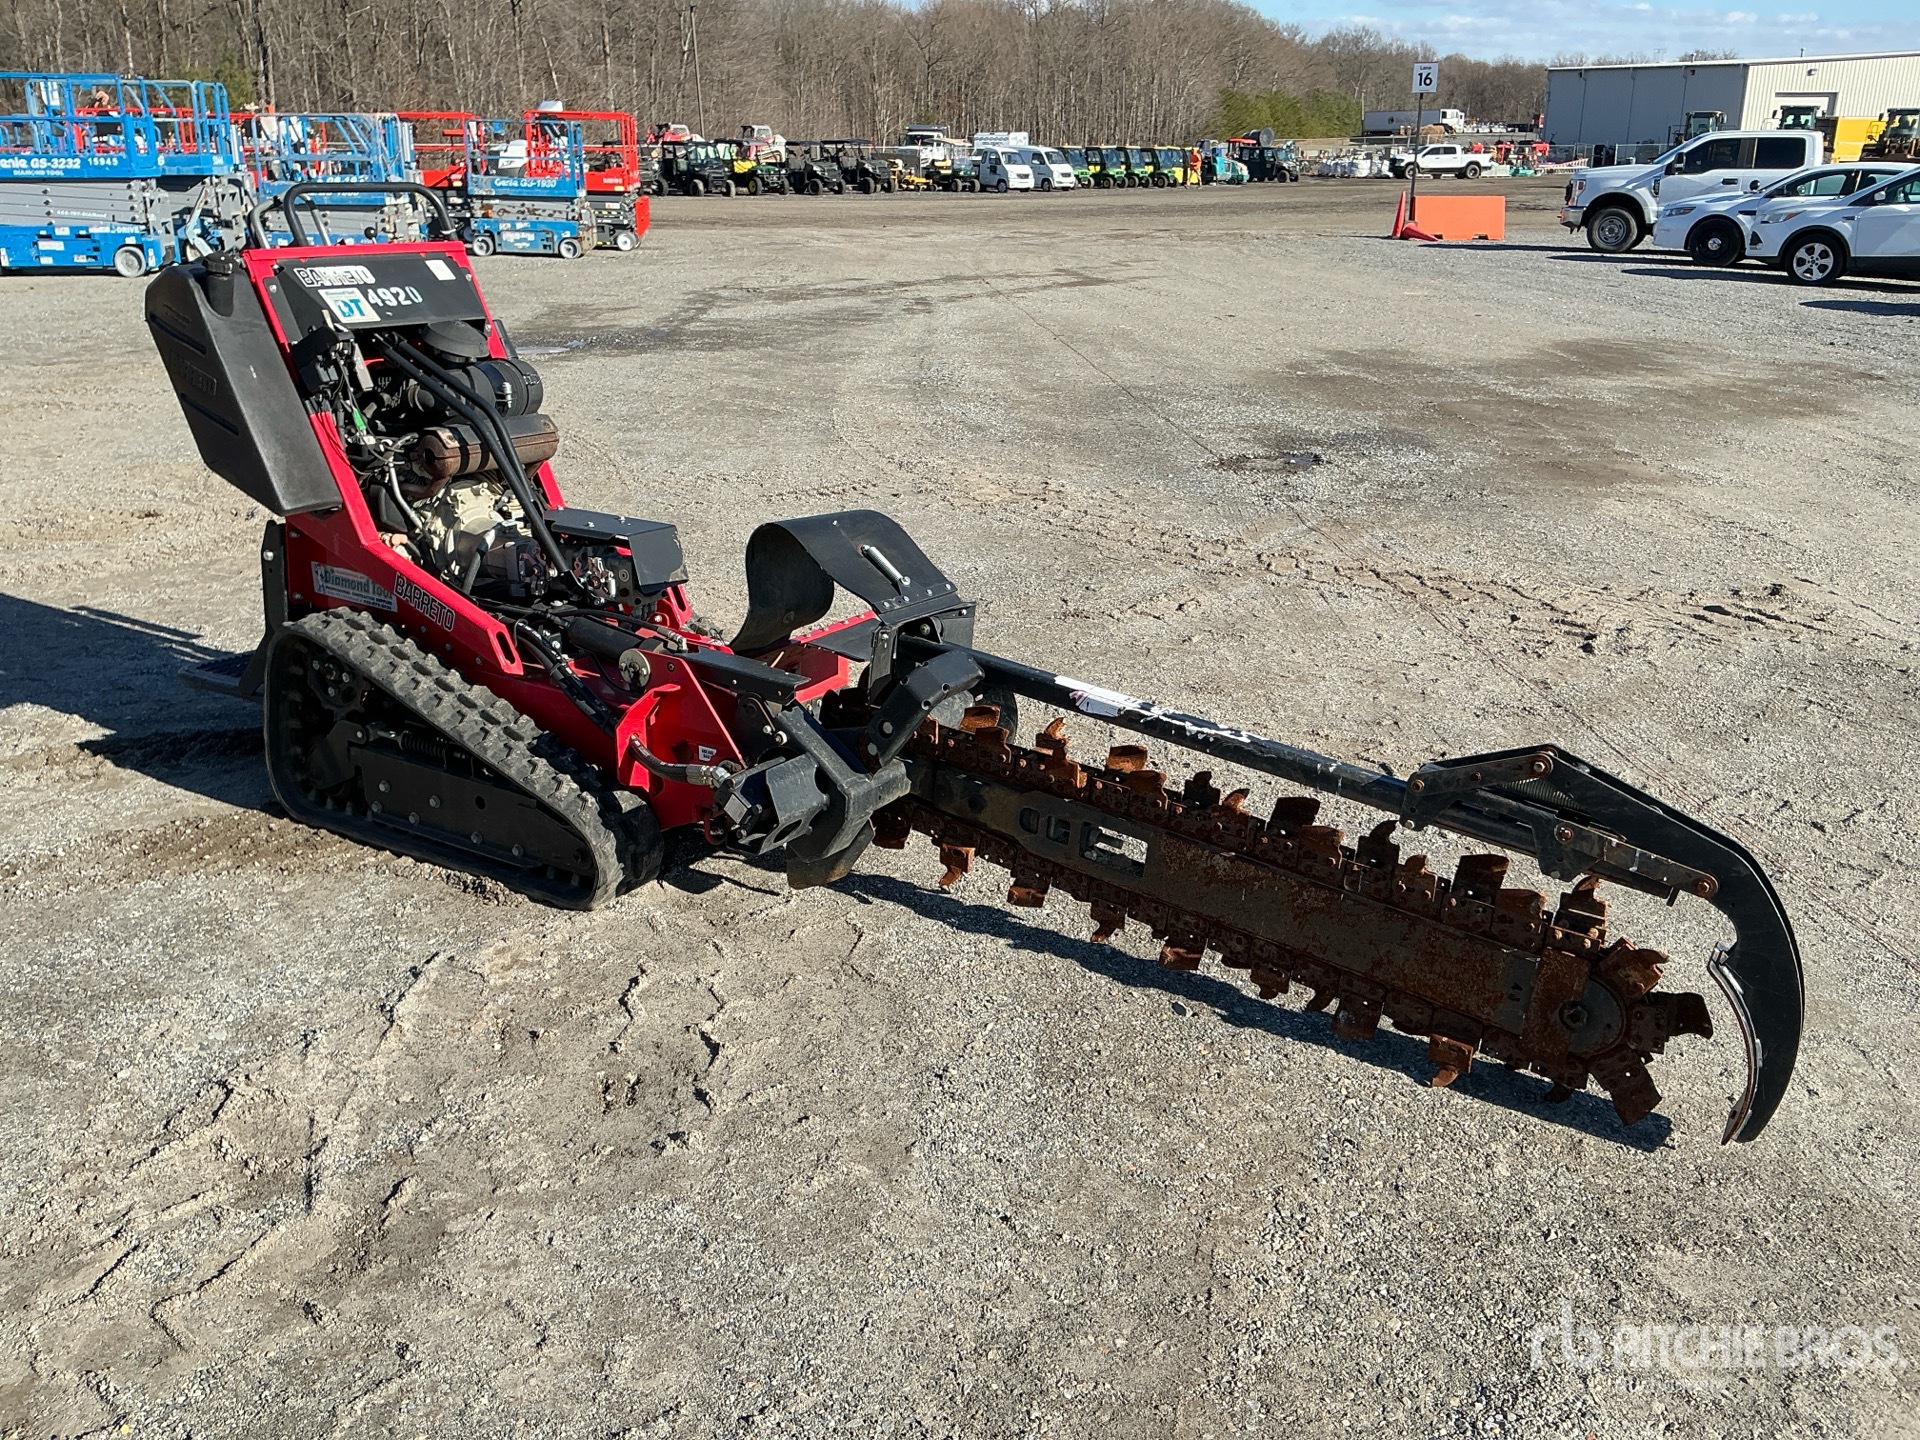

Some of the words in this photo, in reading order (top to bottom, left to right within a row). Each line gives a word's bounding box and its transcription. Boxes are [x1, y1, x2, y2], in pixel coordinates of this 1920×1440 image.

[1417, 72, 1433, 87] 16
[0, 157, 28, 169] enie
[30, 157, 81, 169] GS-3232
[293, 265, 376, 288] BARRETO
[366, 286, 423, 307] 4920
[335, 298, 366, 318] DT
[324, 571, 370, 593] Diamond
[394, 571, 456, 632] BARRETO
